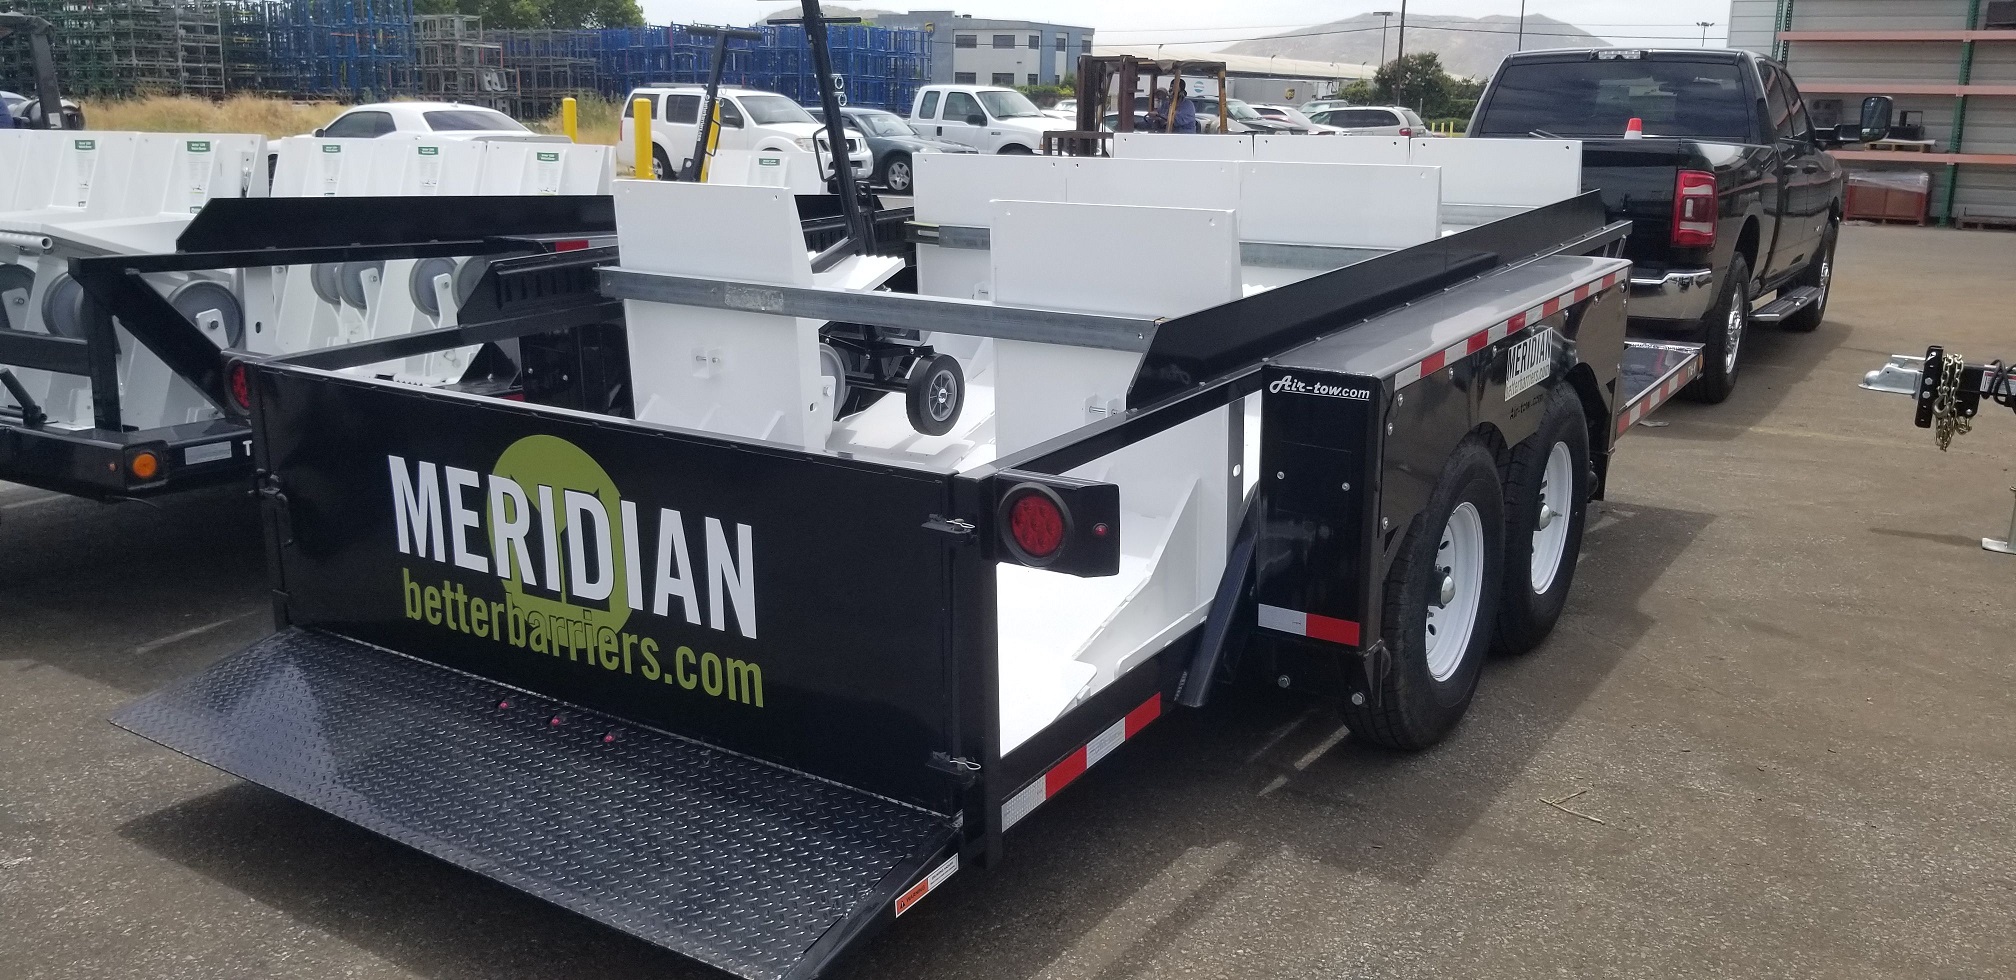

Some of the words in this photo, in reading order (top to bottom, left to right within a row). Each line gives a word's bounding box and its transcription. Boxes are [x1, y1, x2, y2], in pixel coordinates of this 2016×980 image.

[1269, 375, 1370, 400] Air-tow.com
[1506, 329, 1552, 382] MERIDIAN
[388, 455, 757, 639] MERIDIAN
[403, 568, 764, 708] betterbarriers.com
